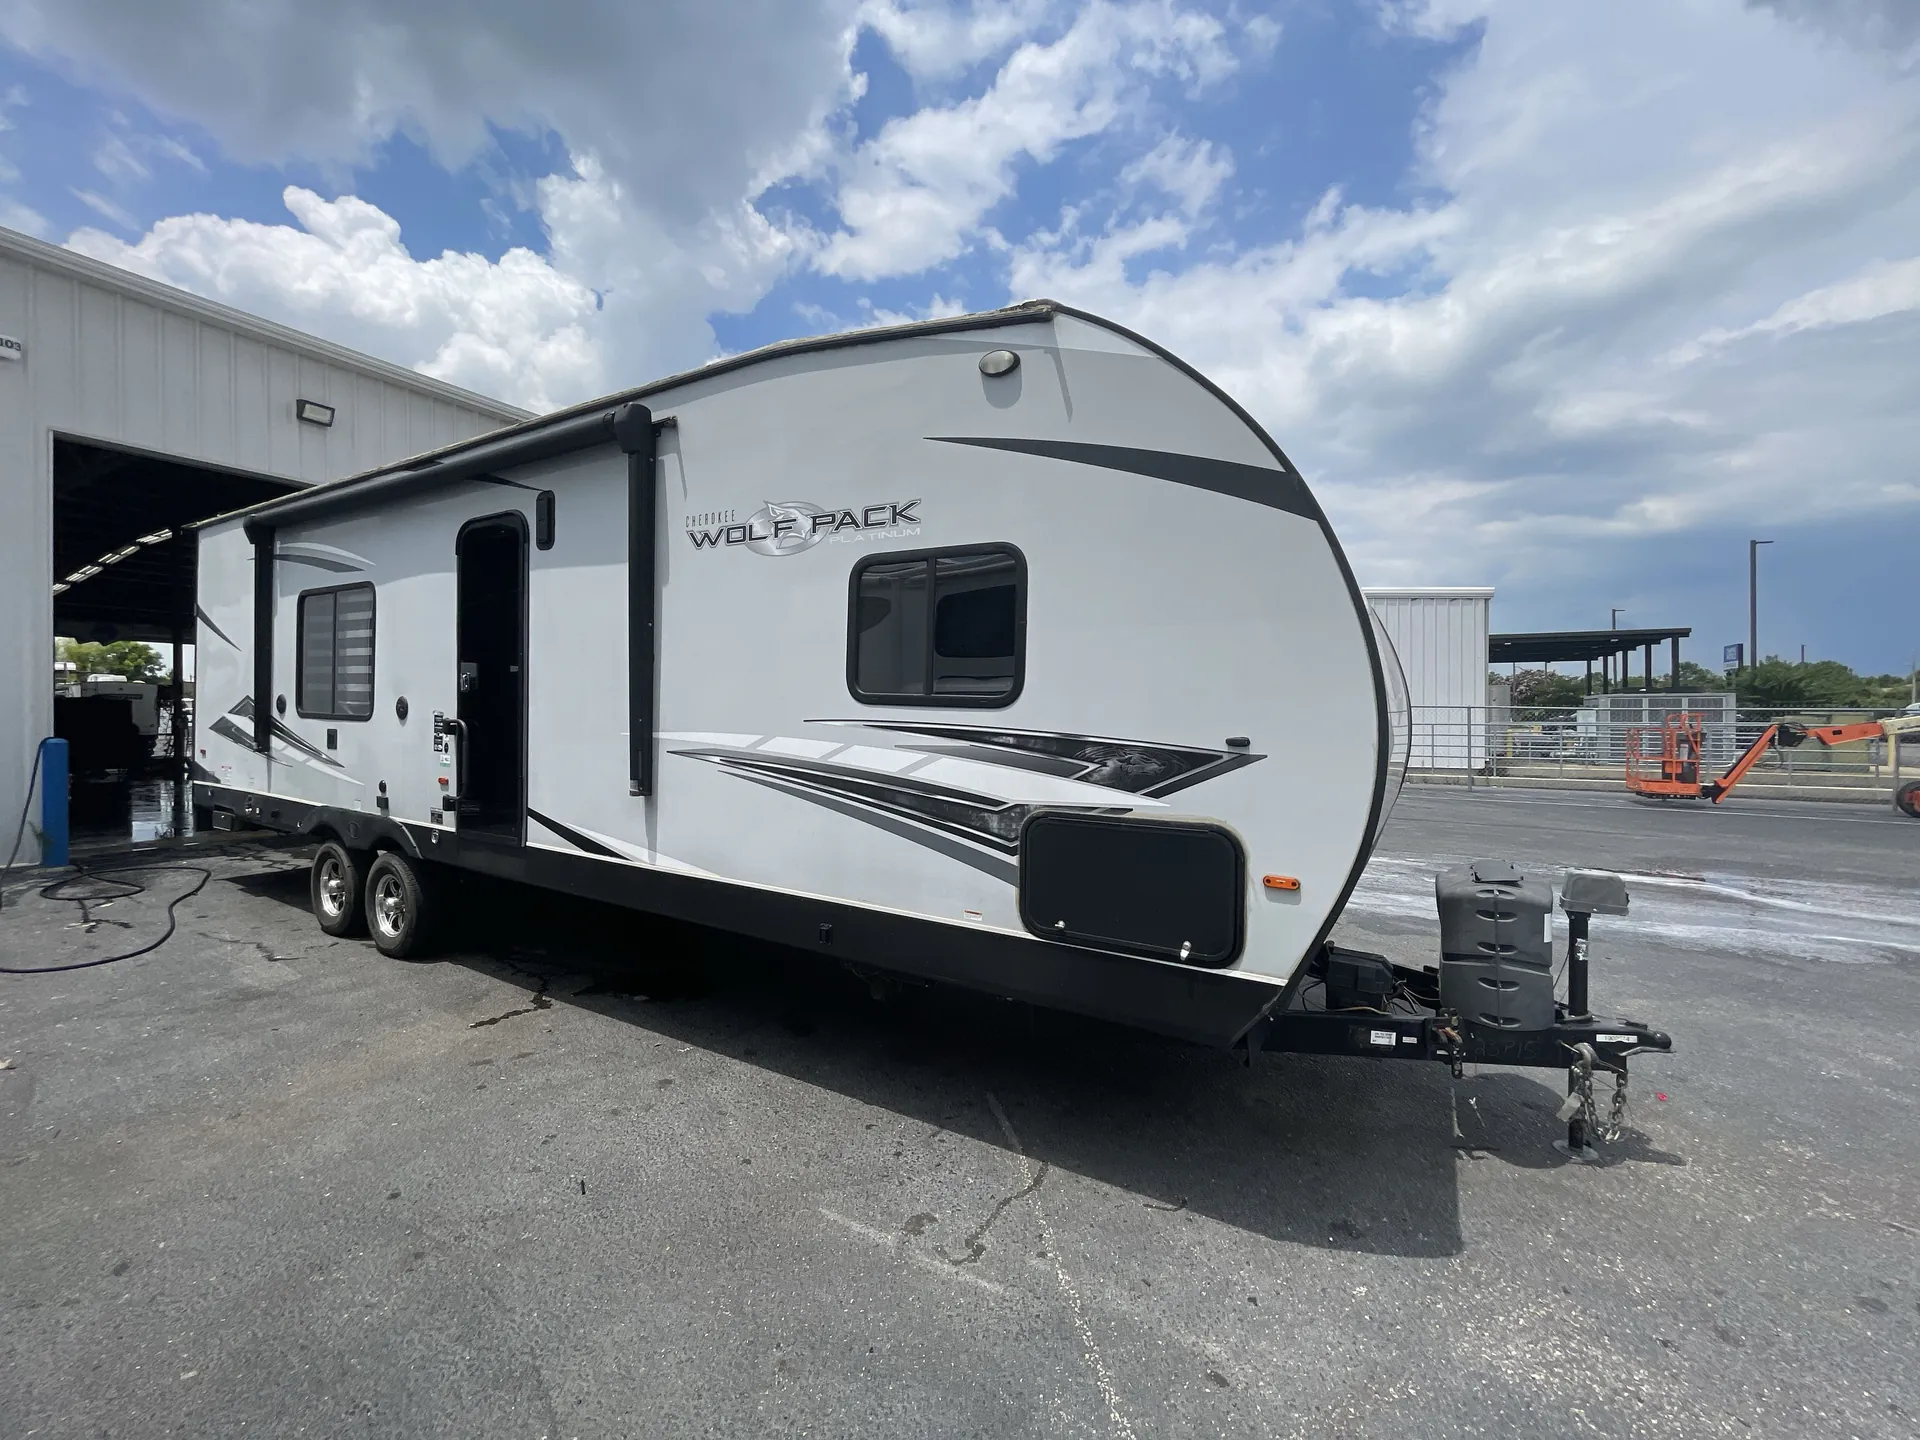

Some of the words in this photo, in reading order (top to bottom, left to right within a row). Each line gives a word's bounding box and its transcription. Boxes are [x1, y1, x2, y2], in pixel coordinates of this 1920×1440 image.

[686, 509, 735, 528] CHEROKEE
[686, 518, 797, 550] WOLF
[808, 498, 921, 535] PACK
[829, 527, 921, 545] PLATINUM
